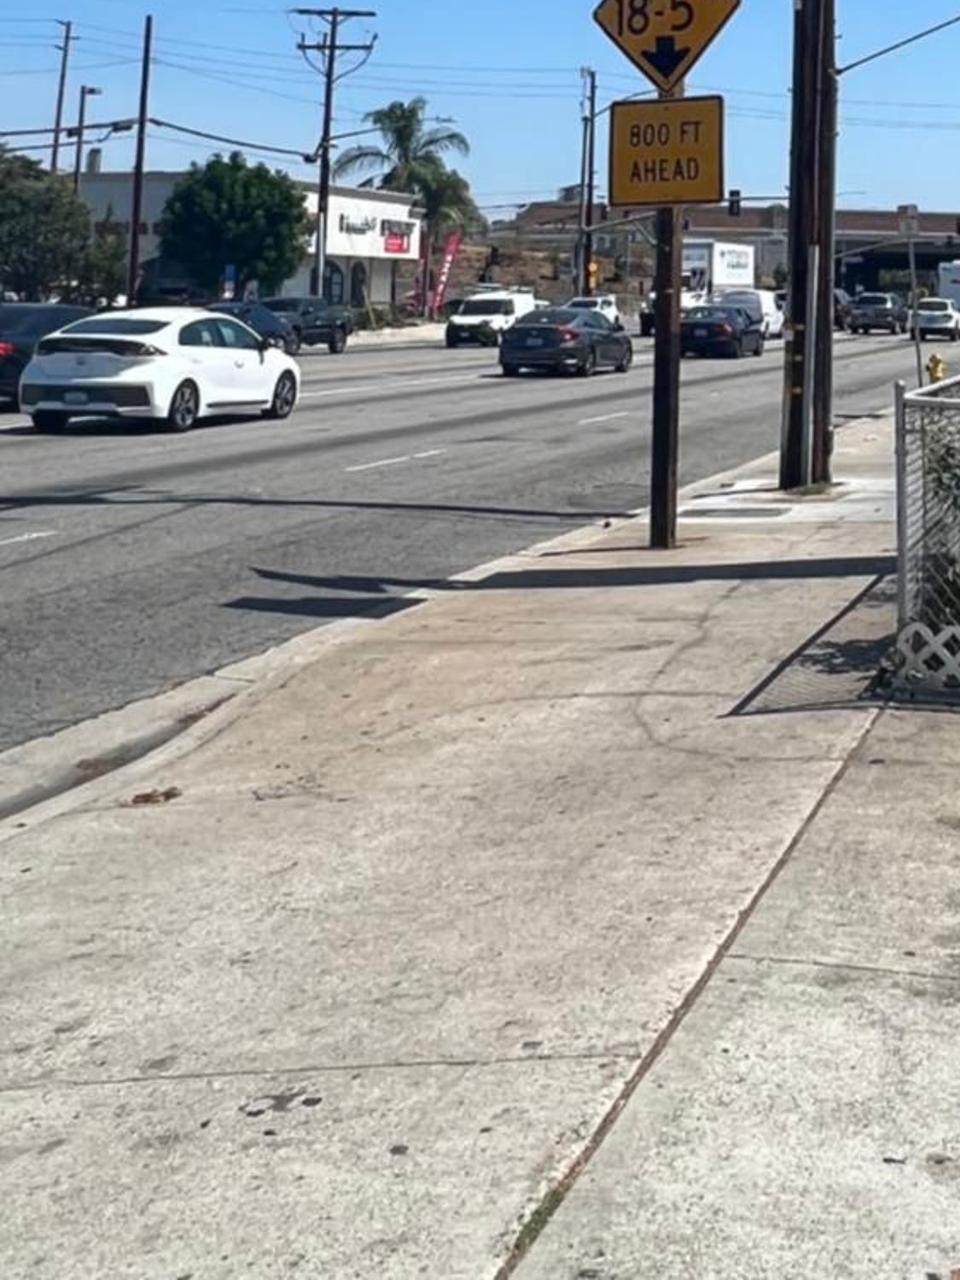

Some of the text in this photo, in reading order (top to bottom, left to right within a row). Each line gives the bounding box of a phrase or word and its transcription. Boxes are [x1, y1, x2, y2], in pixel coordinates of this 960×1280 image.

[630, 121, 703, 148] 800 FT
[630, 156, 699, 184] AHEAD
